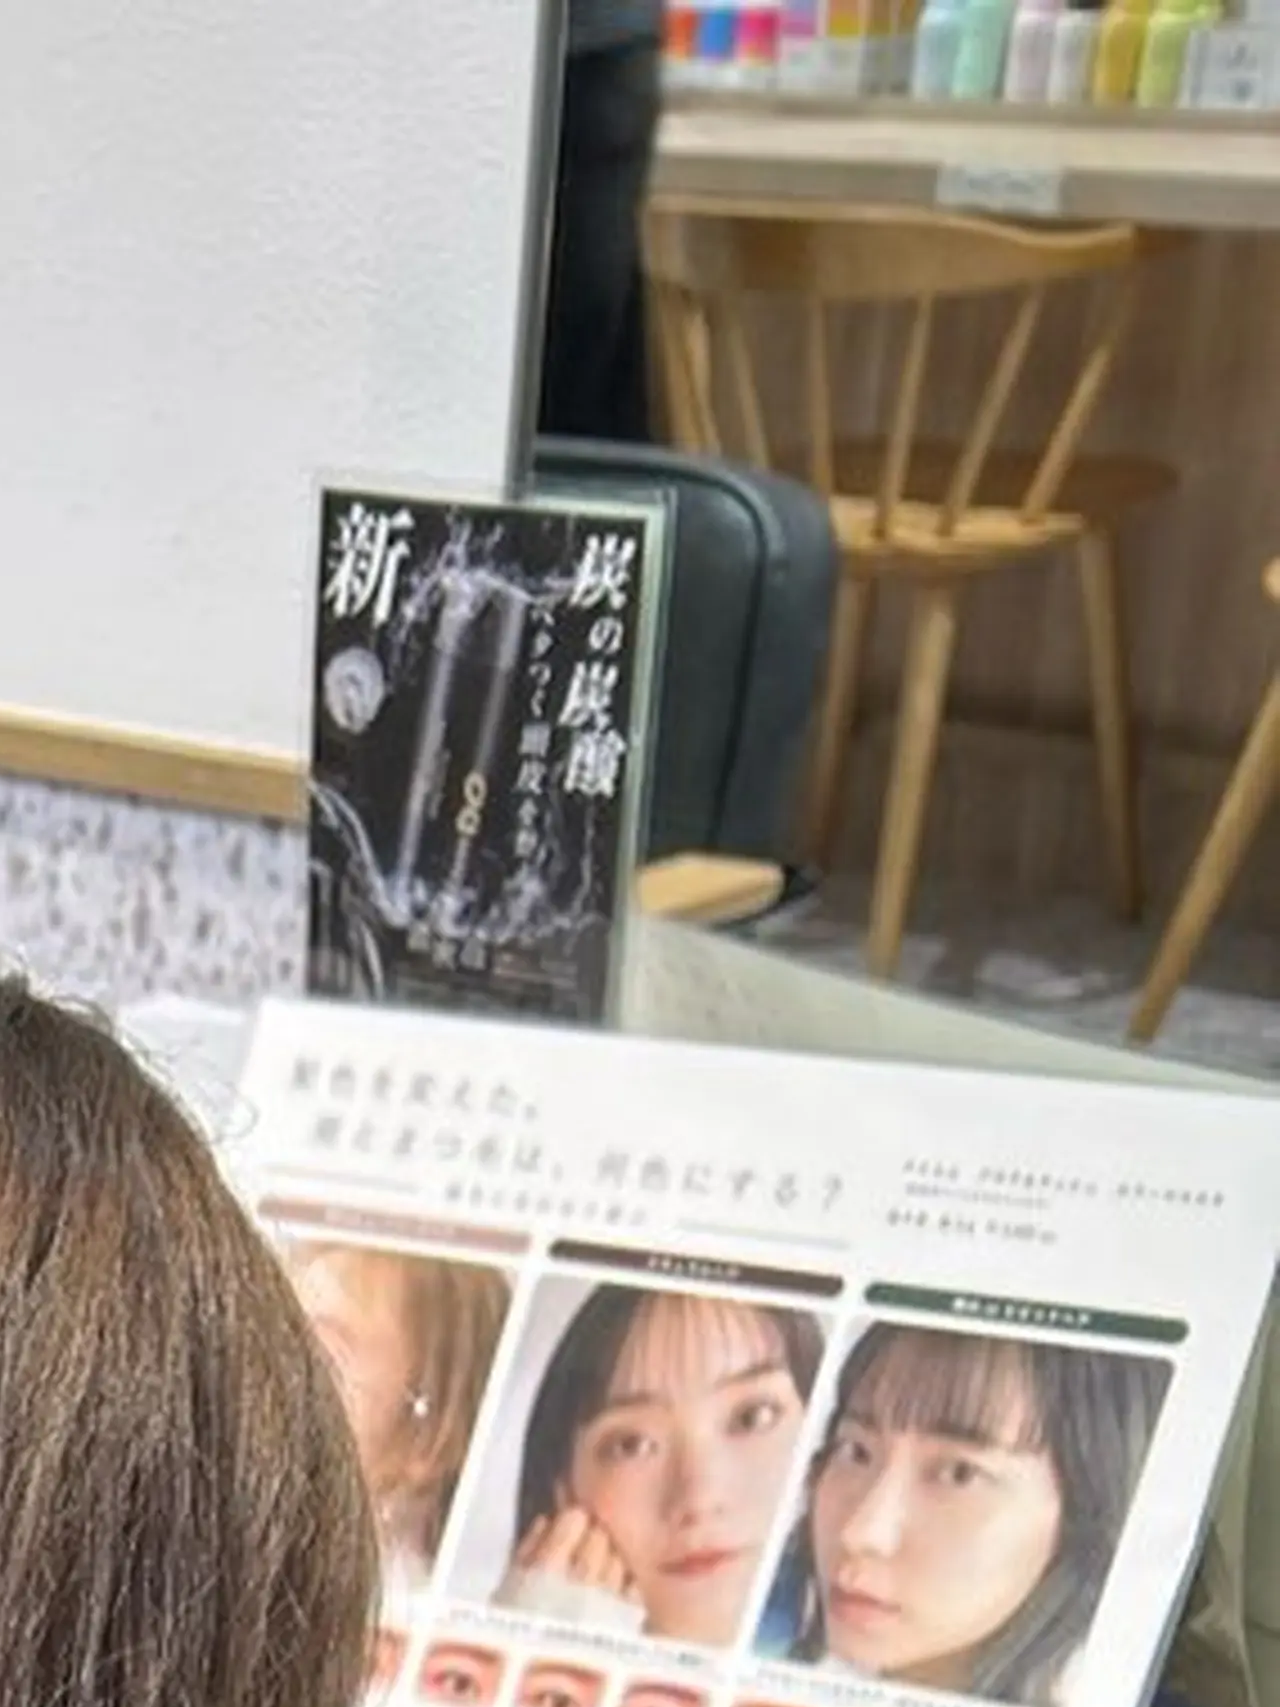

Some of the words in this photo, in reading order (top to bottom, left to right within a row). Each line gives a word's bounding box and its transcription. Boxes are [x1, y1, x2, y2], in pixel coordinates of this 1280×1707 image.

[323, 501, 415, 627] 新
[558, 534, 638, 798] 炭の炭酸
